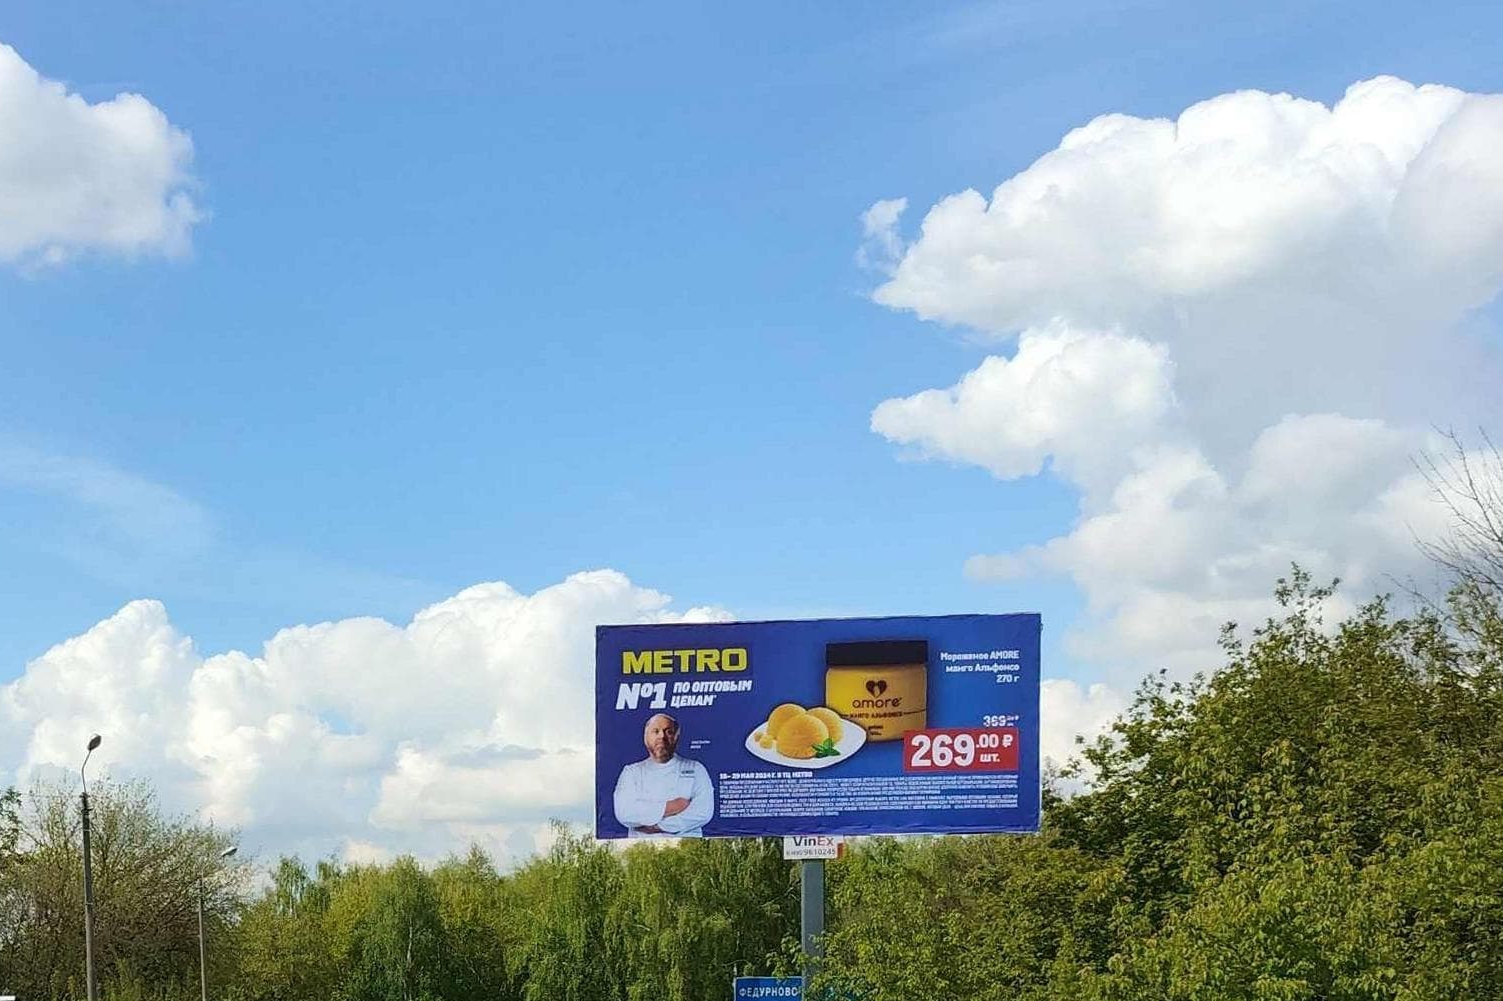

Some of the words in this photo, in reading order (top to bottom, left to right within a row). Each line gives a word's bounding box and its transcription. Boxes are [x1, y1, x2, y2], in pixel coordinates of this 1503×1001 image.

[622, 648, 748, 674] METRO
[990, 650, 1019, 660] AMORE
[996, 674, 1013, 683] 270
[673, 682, 690, 693] ПО
[691, 680, 753, 692] ОПТОВЫМ
[738, 986, 798, 998] ФЕДУРНОВО
